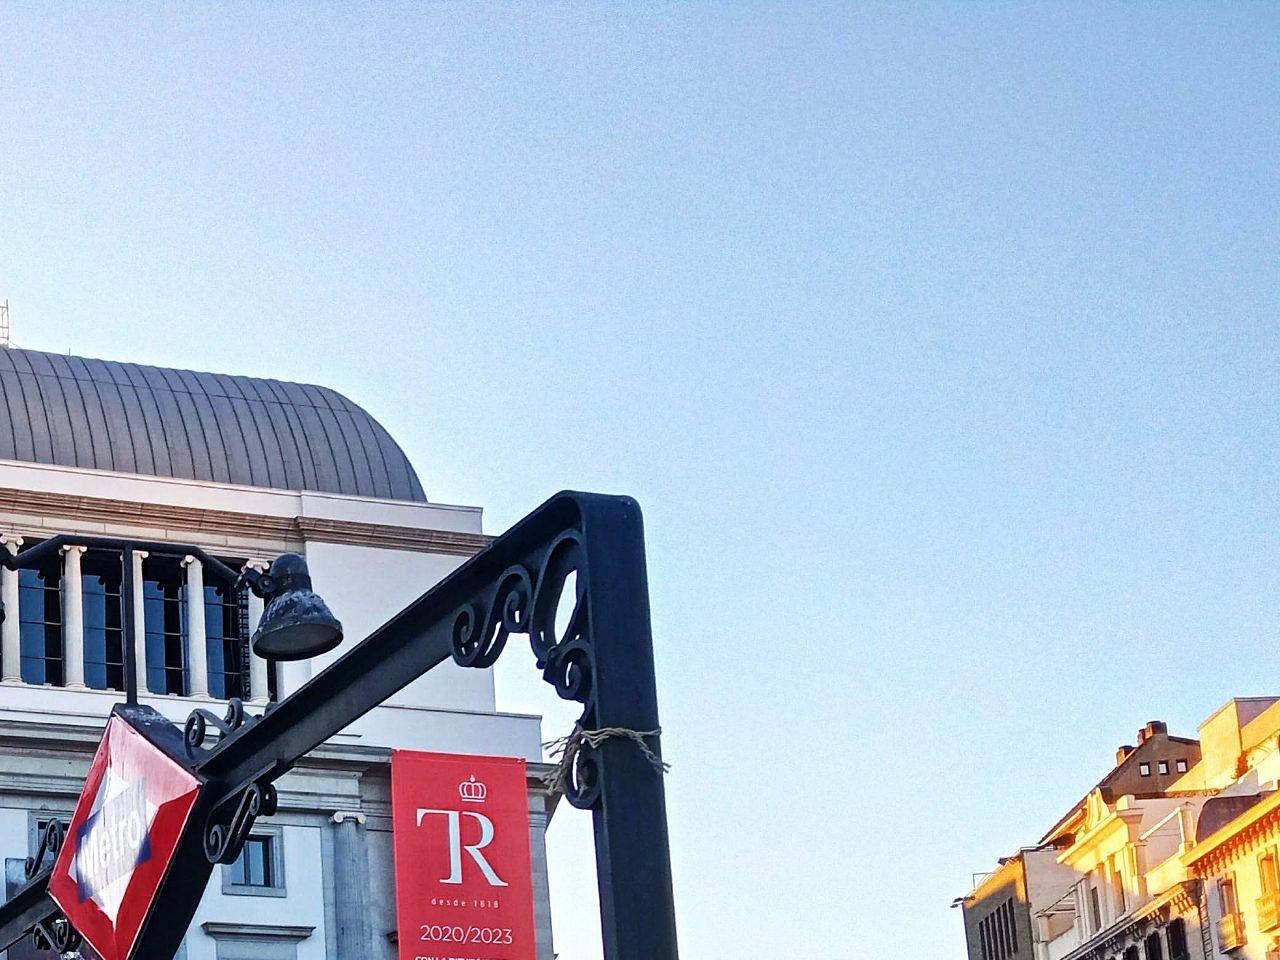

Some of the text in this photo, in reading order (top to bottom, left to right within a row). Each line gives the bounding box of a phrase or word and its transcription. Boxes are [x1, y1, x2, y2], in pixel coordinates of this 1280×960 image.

[77, 810, 140, 878] Metro
[431, 897, 466, 907] desde
[420, 924, 513, 945] 2020/2023
